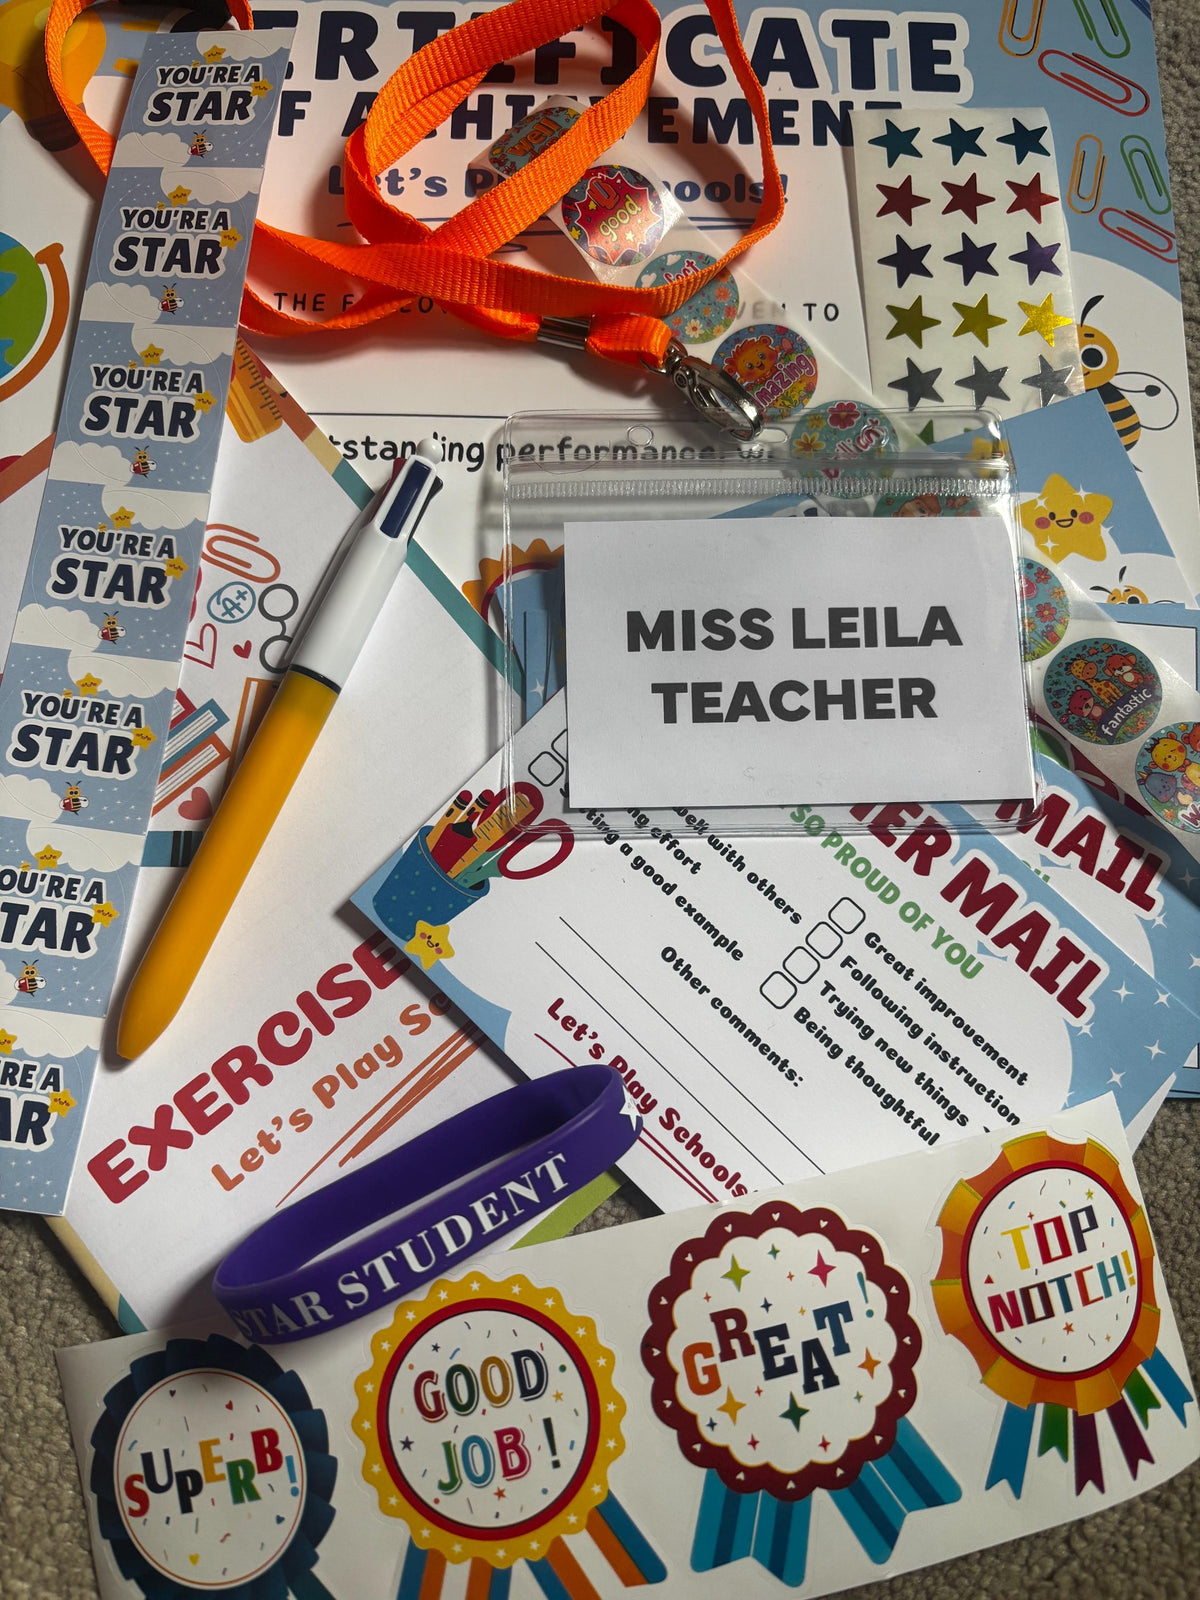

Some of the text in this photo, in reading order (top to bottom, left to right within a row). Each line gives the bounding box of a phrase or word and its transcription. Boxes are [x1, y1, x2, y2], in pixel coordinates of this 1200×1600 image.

[158, 65, 260, 85] YOU'RE A
[252, 10, 961, 92] RTFICATE
[147, 90, 253, 123] STAR
[507, 118, 562, 157] well
[327, 166, 448, 197] Lt's
[122, 208, 229, 231] YOU'RE A
[599, 194, 643, 242] good
[114, 236, 223, 275] STAR
[274, 292, 325, 313] THE
[803, 302, 840, 322] TO
[93, 365, 203, 394] YOU'RE A
[754, 352, 816, 411] mazing
[85, 395, 197, 438] STAR
[328, 432, 484, 473] tstaning
[60, 527, 175, 560] YOU'RE A
[51, 558, 168, 605] STAR
[626, 605, 964, 652] MISS LEILA
[23, 692, 142, 729] YOU'RE A
[650, 677, 938, 724] TEACHER
[1102, 686, 1153, 738] fantastic
[12, 724, 134, 776] STAR
[650, 826, 702, 875] effort
[0, 868, 104, 904] OU'RE A
[619, 842, 633, 857] a
[631, 854, 678, 896] good
[675, 896, 744, 961] example
[707, 833, 746, 872] with
[747, 872, 803, 925] others
[821, 830, 901, 905] PROUD
[899, 900, 935, 934] OF
[930, 926, 985, 980] YOU
[0, 901, 96, 954] TAR
[940, 857, 1102, 1019] MAIL
[660, 946, 804, 1088] Other comments:
[840, 955, 924, 1039] Following
[864, 932, 1030, 1087] Great improvement
[87, 931, 411, 1204] EXERCISE
[547, 997, 605, 1060] Let's
[608, 1054, 658, 1115] Play
[793, 1005, 940, 1147] Being thoughtful
[819, 979, 970, 1128] Trying new things
[40, 1067, 61, 1093] A
[211, 1034, 404, 1192] Let's Play
[233, 1152, 570, 1341] STAR STUDENT
[1001, 1204, 1099, 1271] TOP
[986, 1250, 1136, 1334] NOTCH!
[413, 1348, 549, 1422] GOOD
[124, 1427, 300, 1518] SUPERB!
